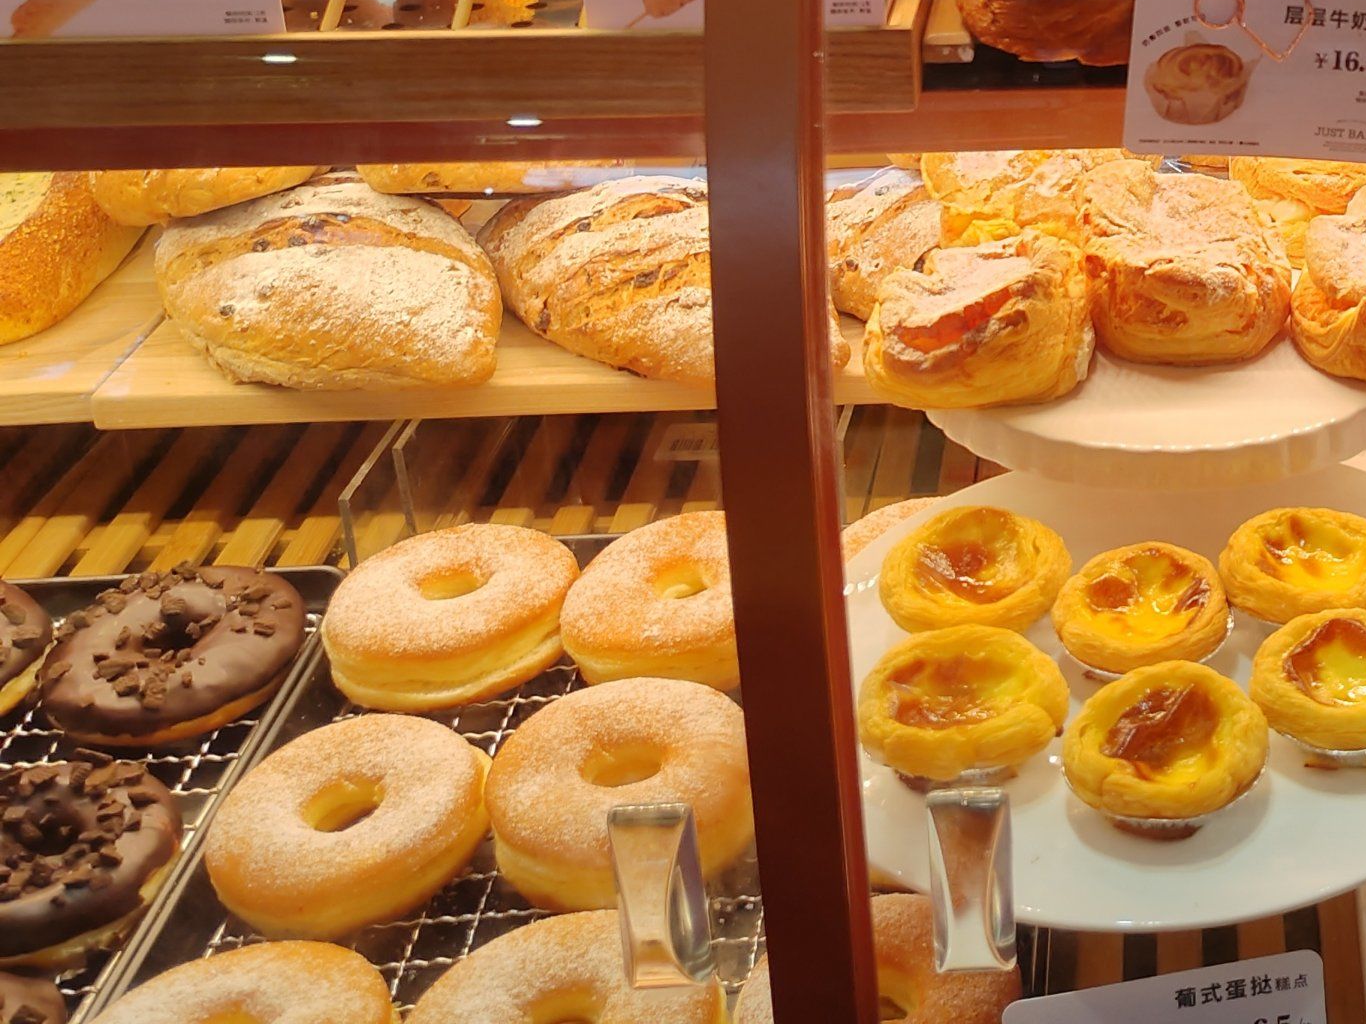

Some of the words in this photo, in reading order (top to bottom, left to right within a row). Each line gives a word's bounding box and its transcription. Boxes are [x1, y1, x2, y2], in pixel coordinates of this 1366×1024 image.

[1314, 126, 1345, 138] JUST
[1174, 974, 1309, 1009] 葡式蛋挞糕点
